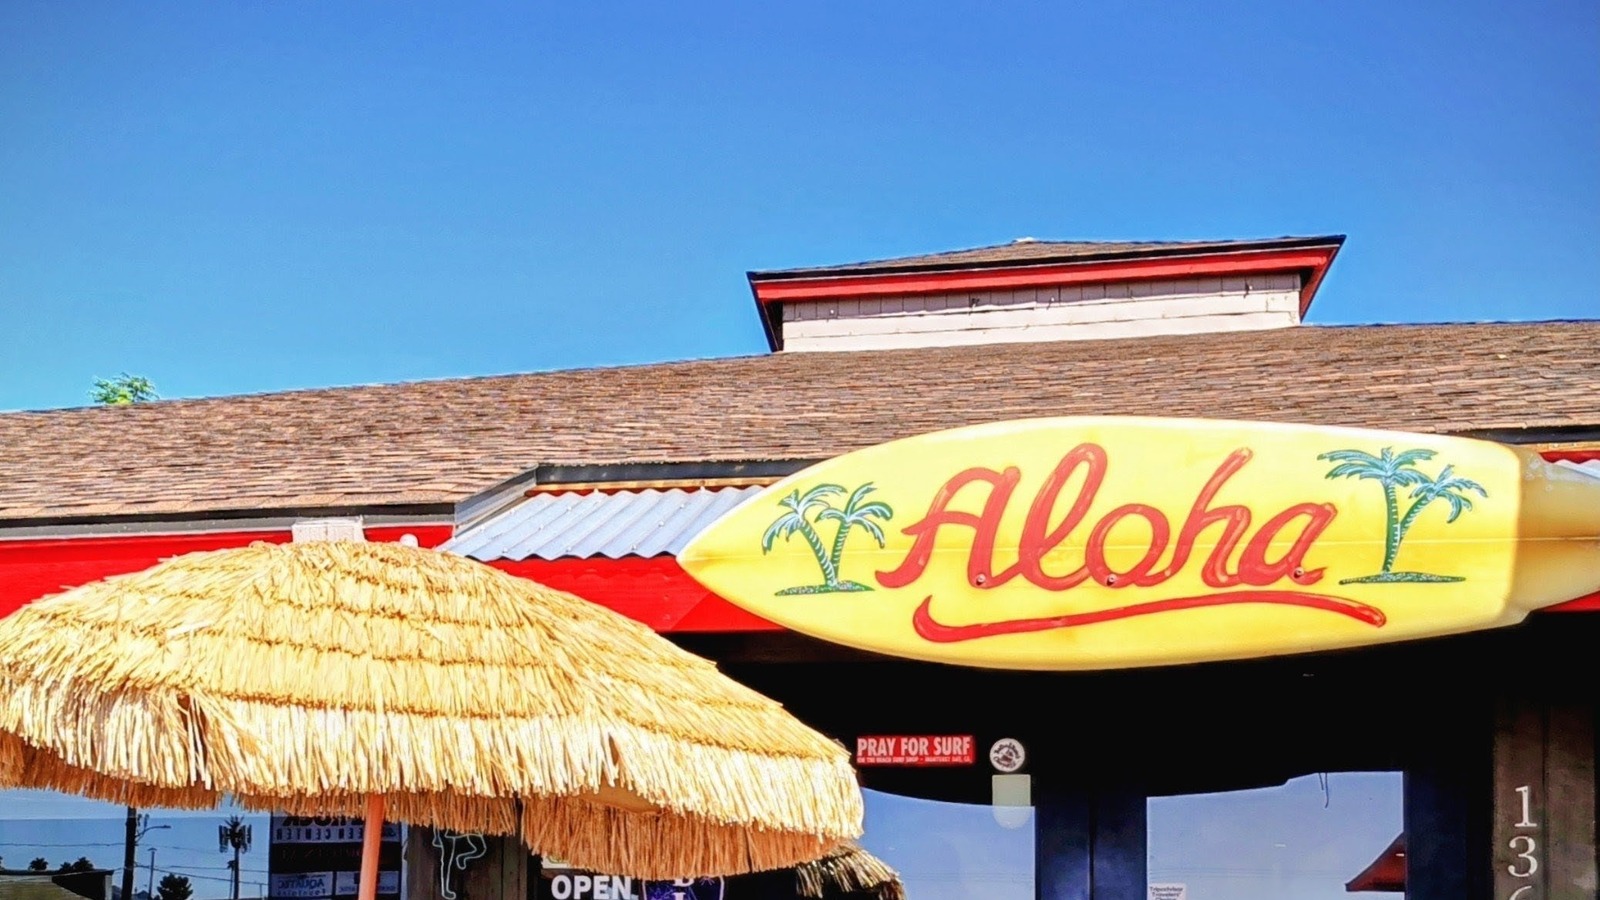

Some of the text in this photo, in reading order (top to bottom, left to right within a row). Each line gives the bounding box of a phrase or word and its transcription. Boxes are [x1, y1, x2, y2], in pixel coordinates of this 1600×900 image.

[874, 442, 1338, 592] Aloha
[857, 738, 896, 756] PRAY
[901, 737, 929, 756] FOR
[933, 736, 971, 756] SURF
[551, 874, 632, 900] OPEN
